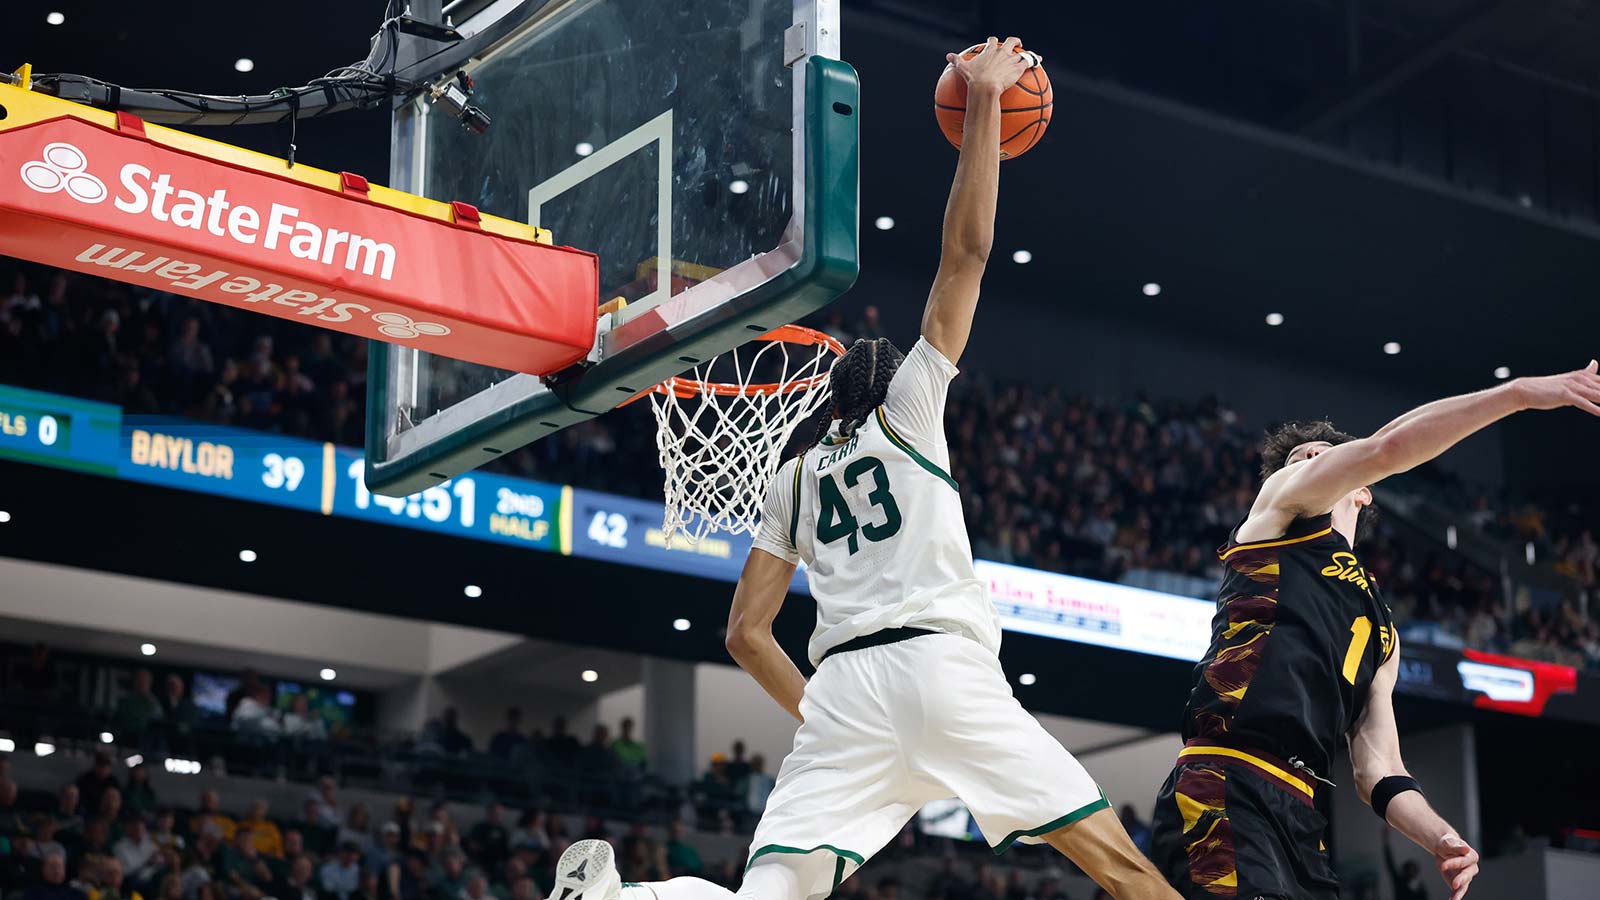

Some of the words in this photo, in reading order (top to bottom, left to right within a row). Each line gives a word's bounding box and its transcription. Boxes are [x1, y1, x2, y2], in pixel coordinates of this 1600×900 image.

[39, 415, 58, 446] 0
[131, 429, 234, 480] BAYLOR
[262, 453, 305, 491] 39
[497, 487, 544, 517] 2ND
[817, 456, 902, 556] 43
[489, 512, 549, 541] HALF
[588, 510, 628, 548] 42
